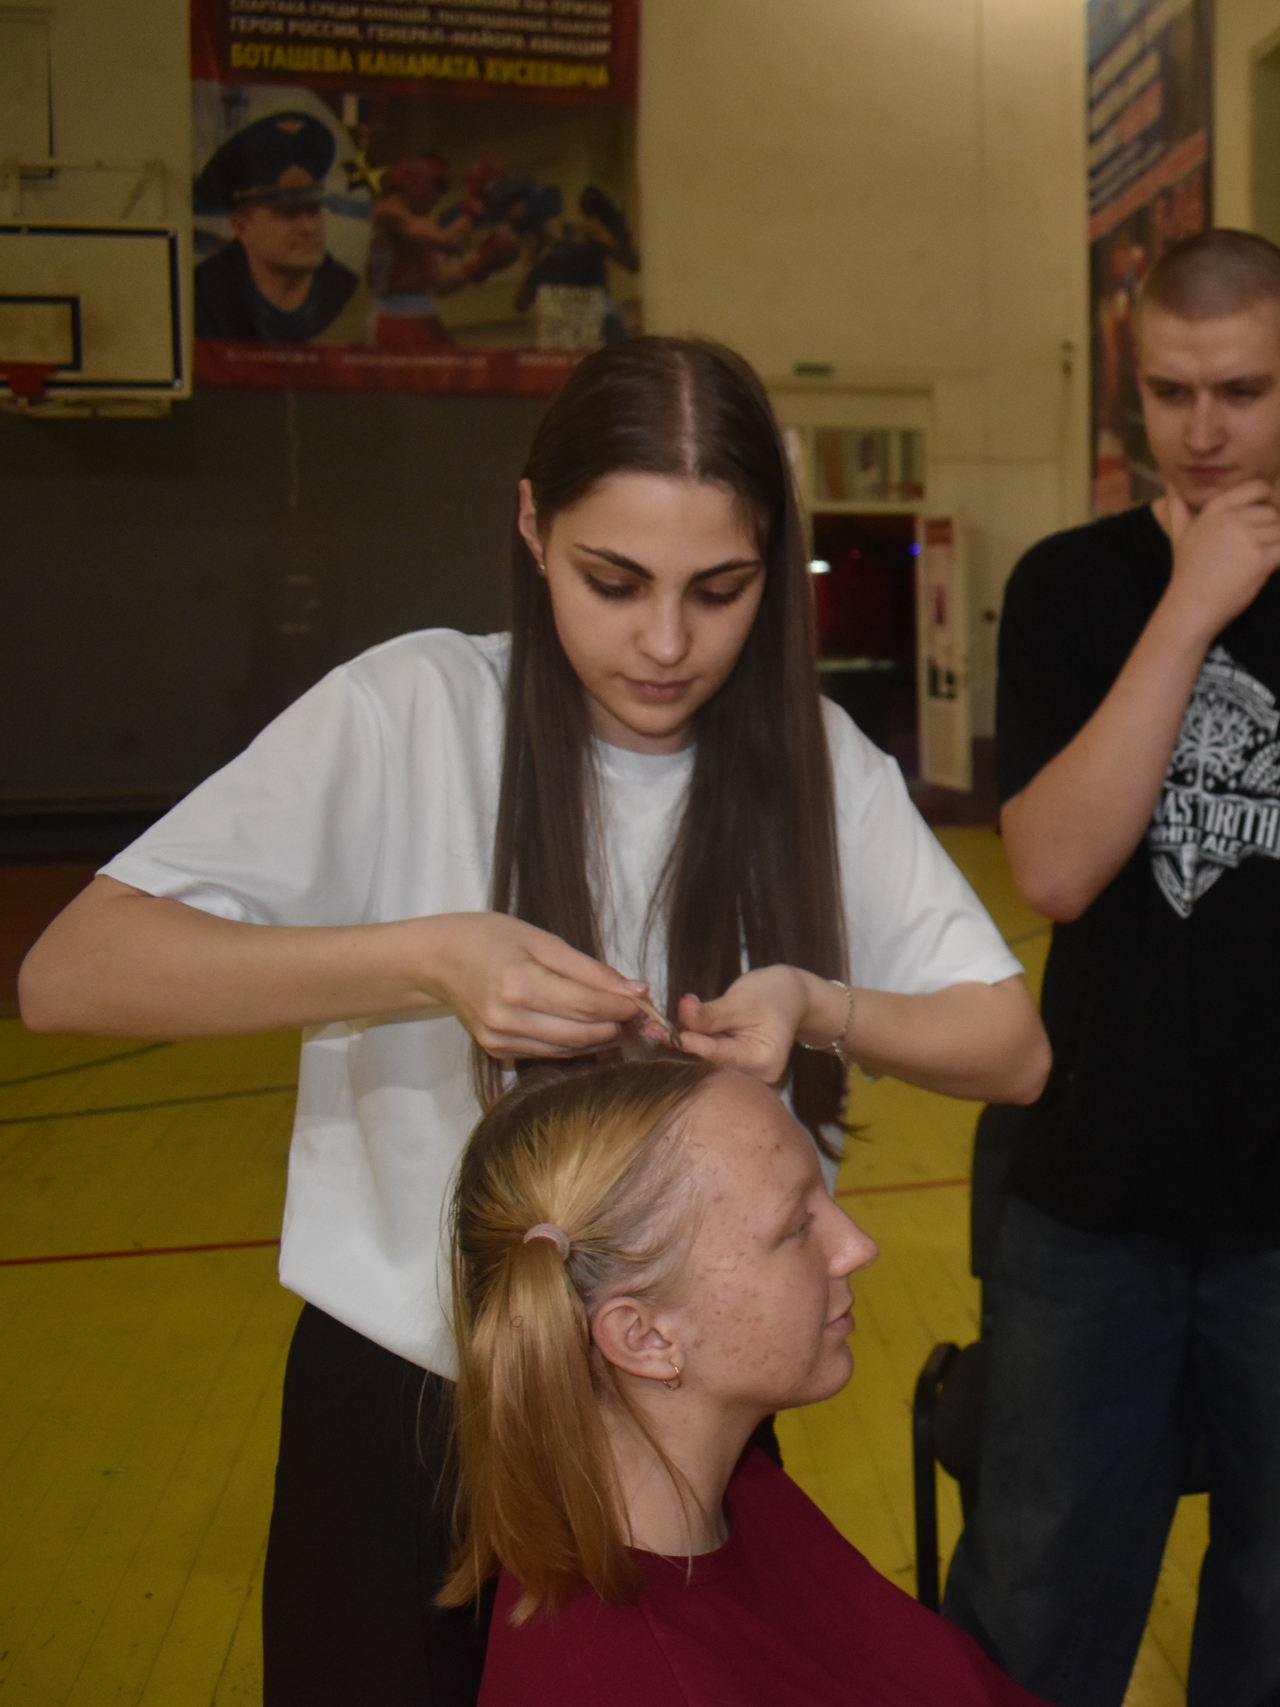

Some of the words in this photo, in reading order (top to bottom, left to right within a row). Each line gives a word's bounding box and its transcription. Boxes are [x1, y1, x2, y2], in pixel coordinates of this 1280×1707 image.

[229, 14, 284, 34] ГЕРОЯ
[230, 41, 354, 73] БОТАШЕВА
[358, 48, 479, 80] КАНАМАТА
[484, 57, 610, 89] ХУСЕЕВИЧА
[1202, 833, 1242, 855] ALE
